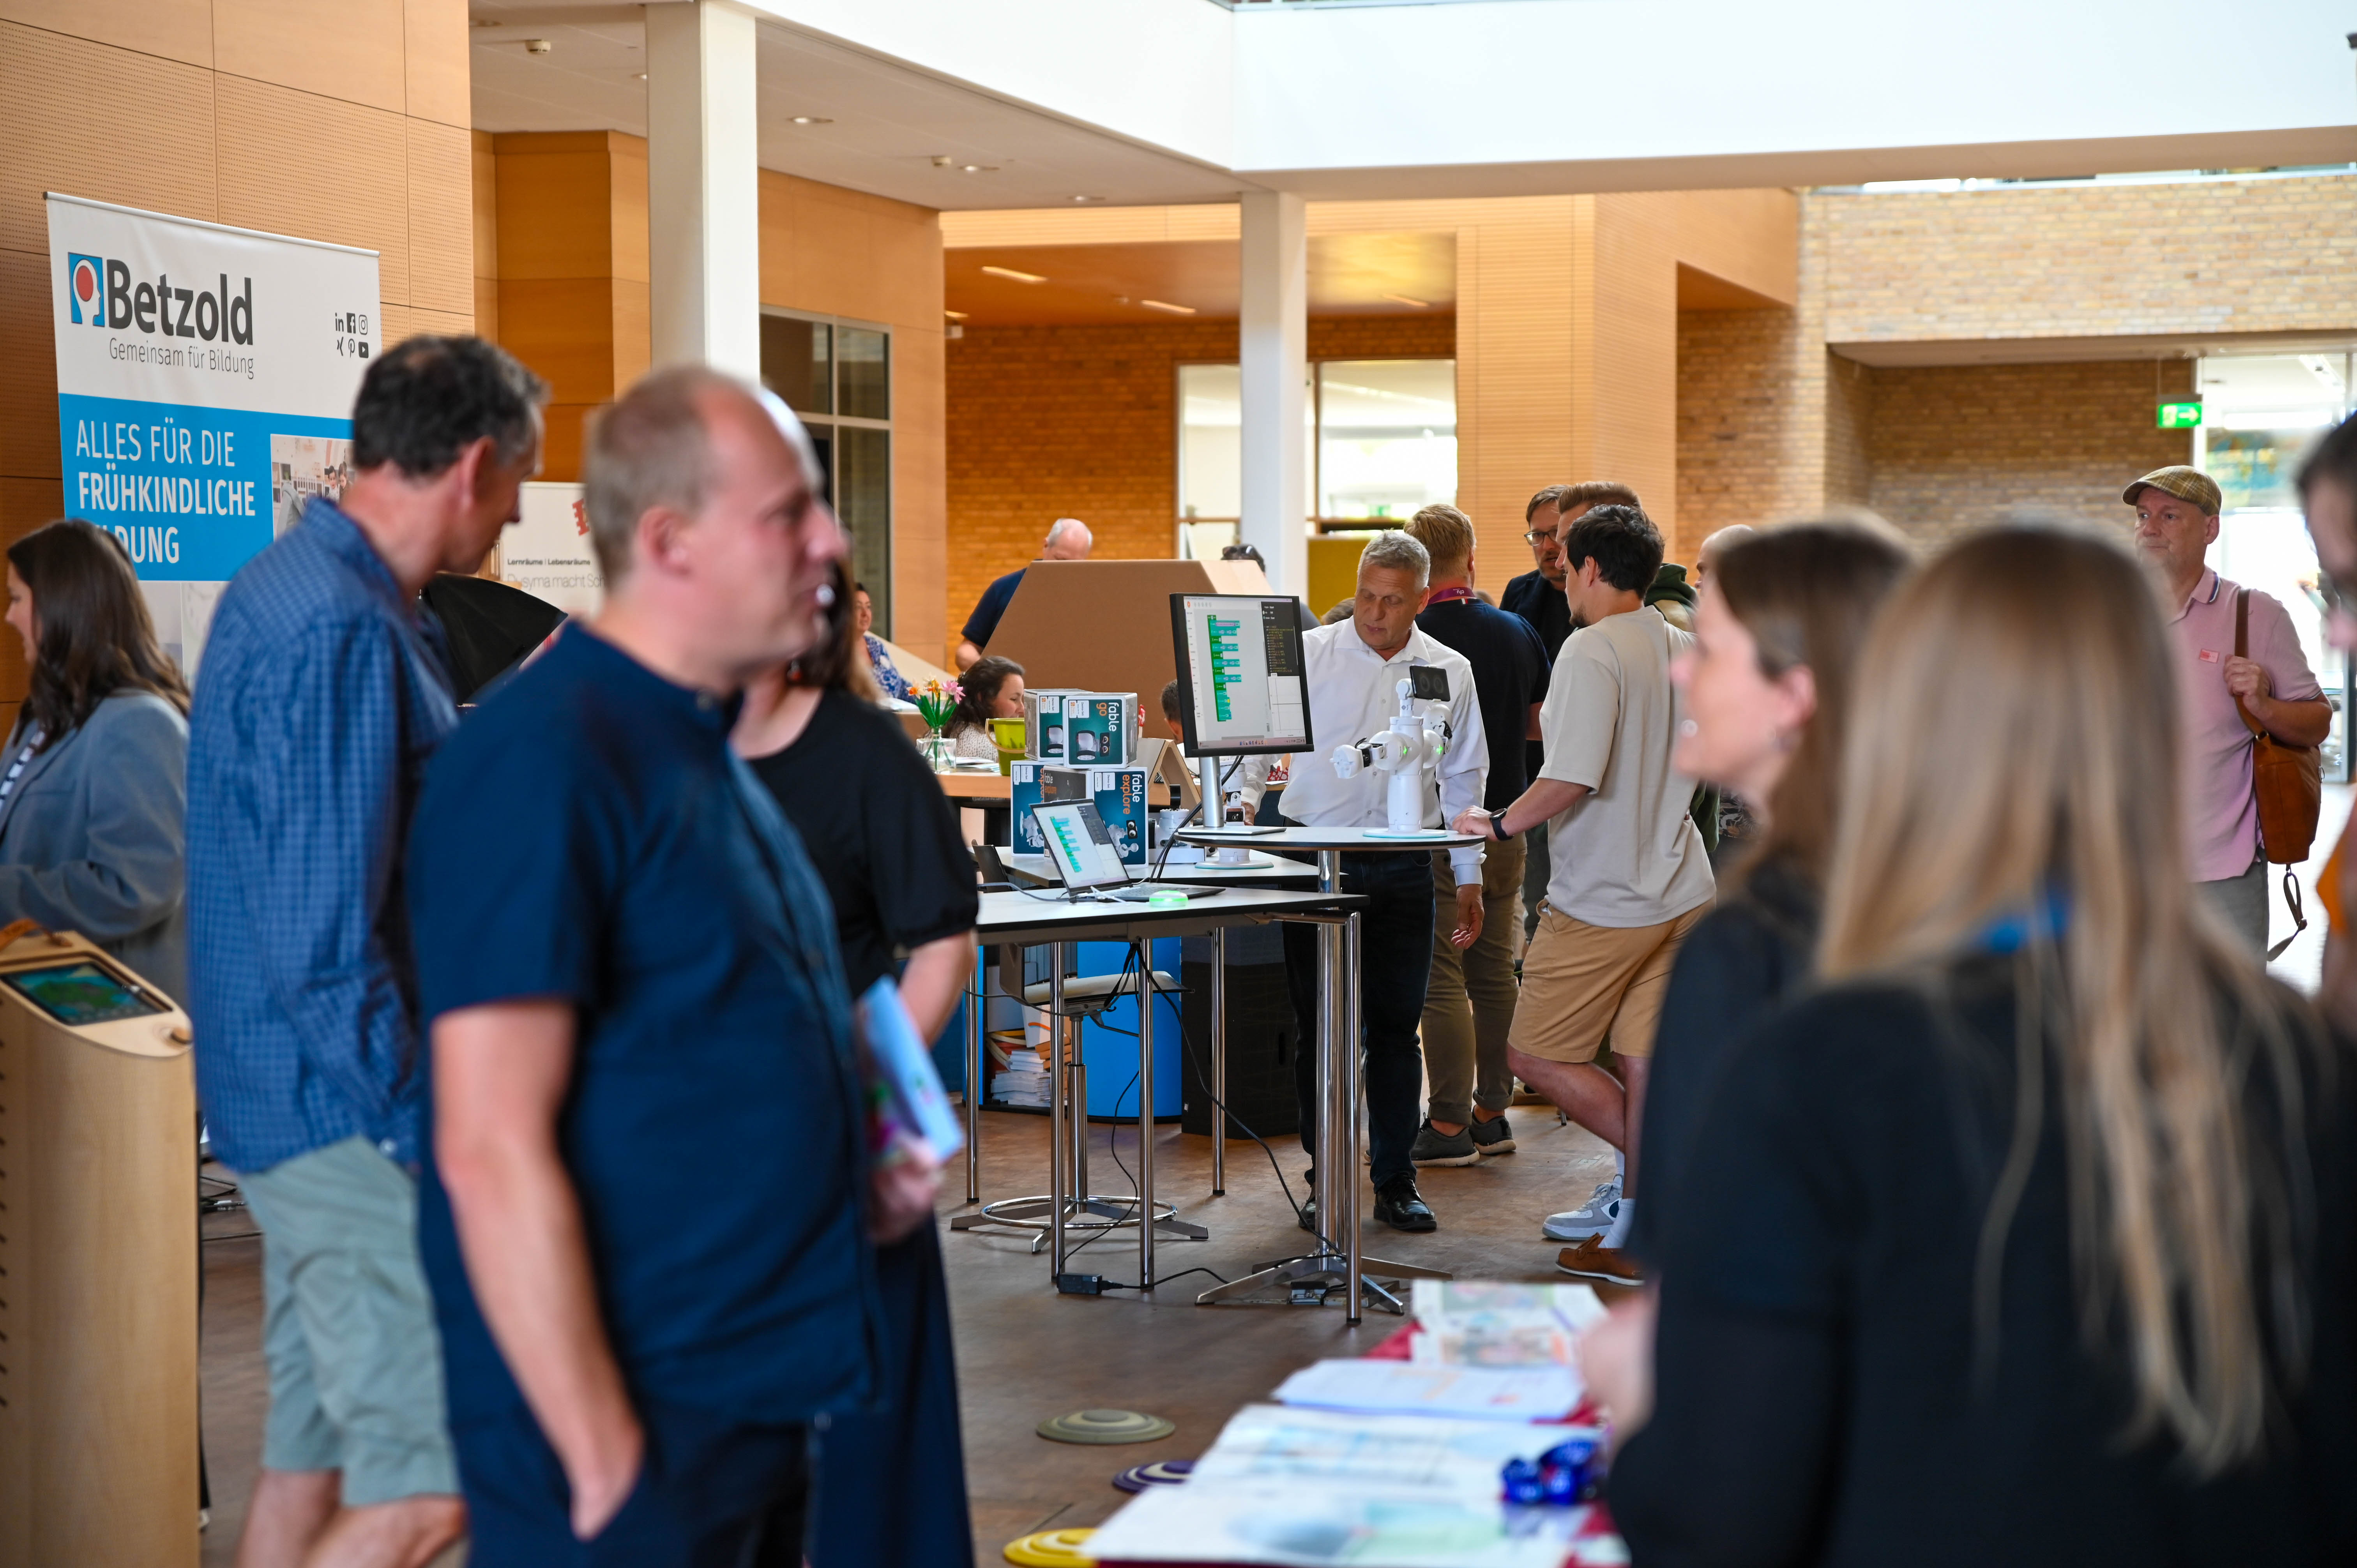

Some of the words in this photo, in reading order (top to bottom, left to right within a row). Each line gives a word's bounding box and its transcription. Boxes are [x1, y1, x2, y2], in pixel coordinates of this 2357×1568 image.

[107, 259, 253, 346] Betzold
[110, 337, 184, 367] Gemeinsam
[188, 345, 205, 369] für
[210, 350, 254, 380] Bildung
[77, 420, 141, 461] ALLES
[151, 417, 193, 464] FÜR
[201, 430, 235, 467] DIE
[79, 462, 255, 516] FRÜHKINDLICHE
[96, 525, 179, 563] DUNG
[553, 574, 585, 588] macht
[587, 573, 605, 588] Sch
[1096, 702, 1107, 716] go
[1108, 702, 1119, 732] fable
[1044, 773, 1053, 784] fable
[1120, 774, 1132, 814] explore
[1132, 774, 1142, 803] fable
